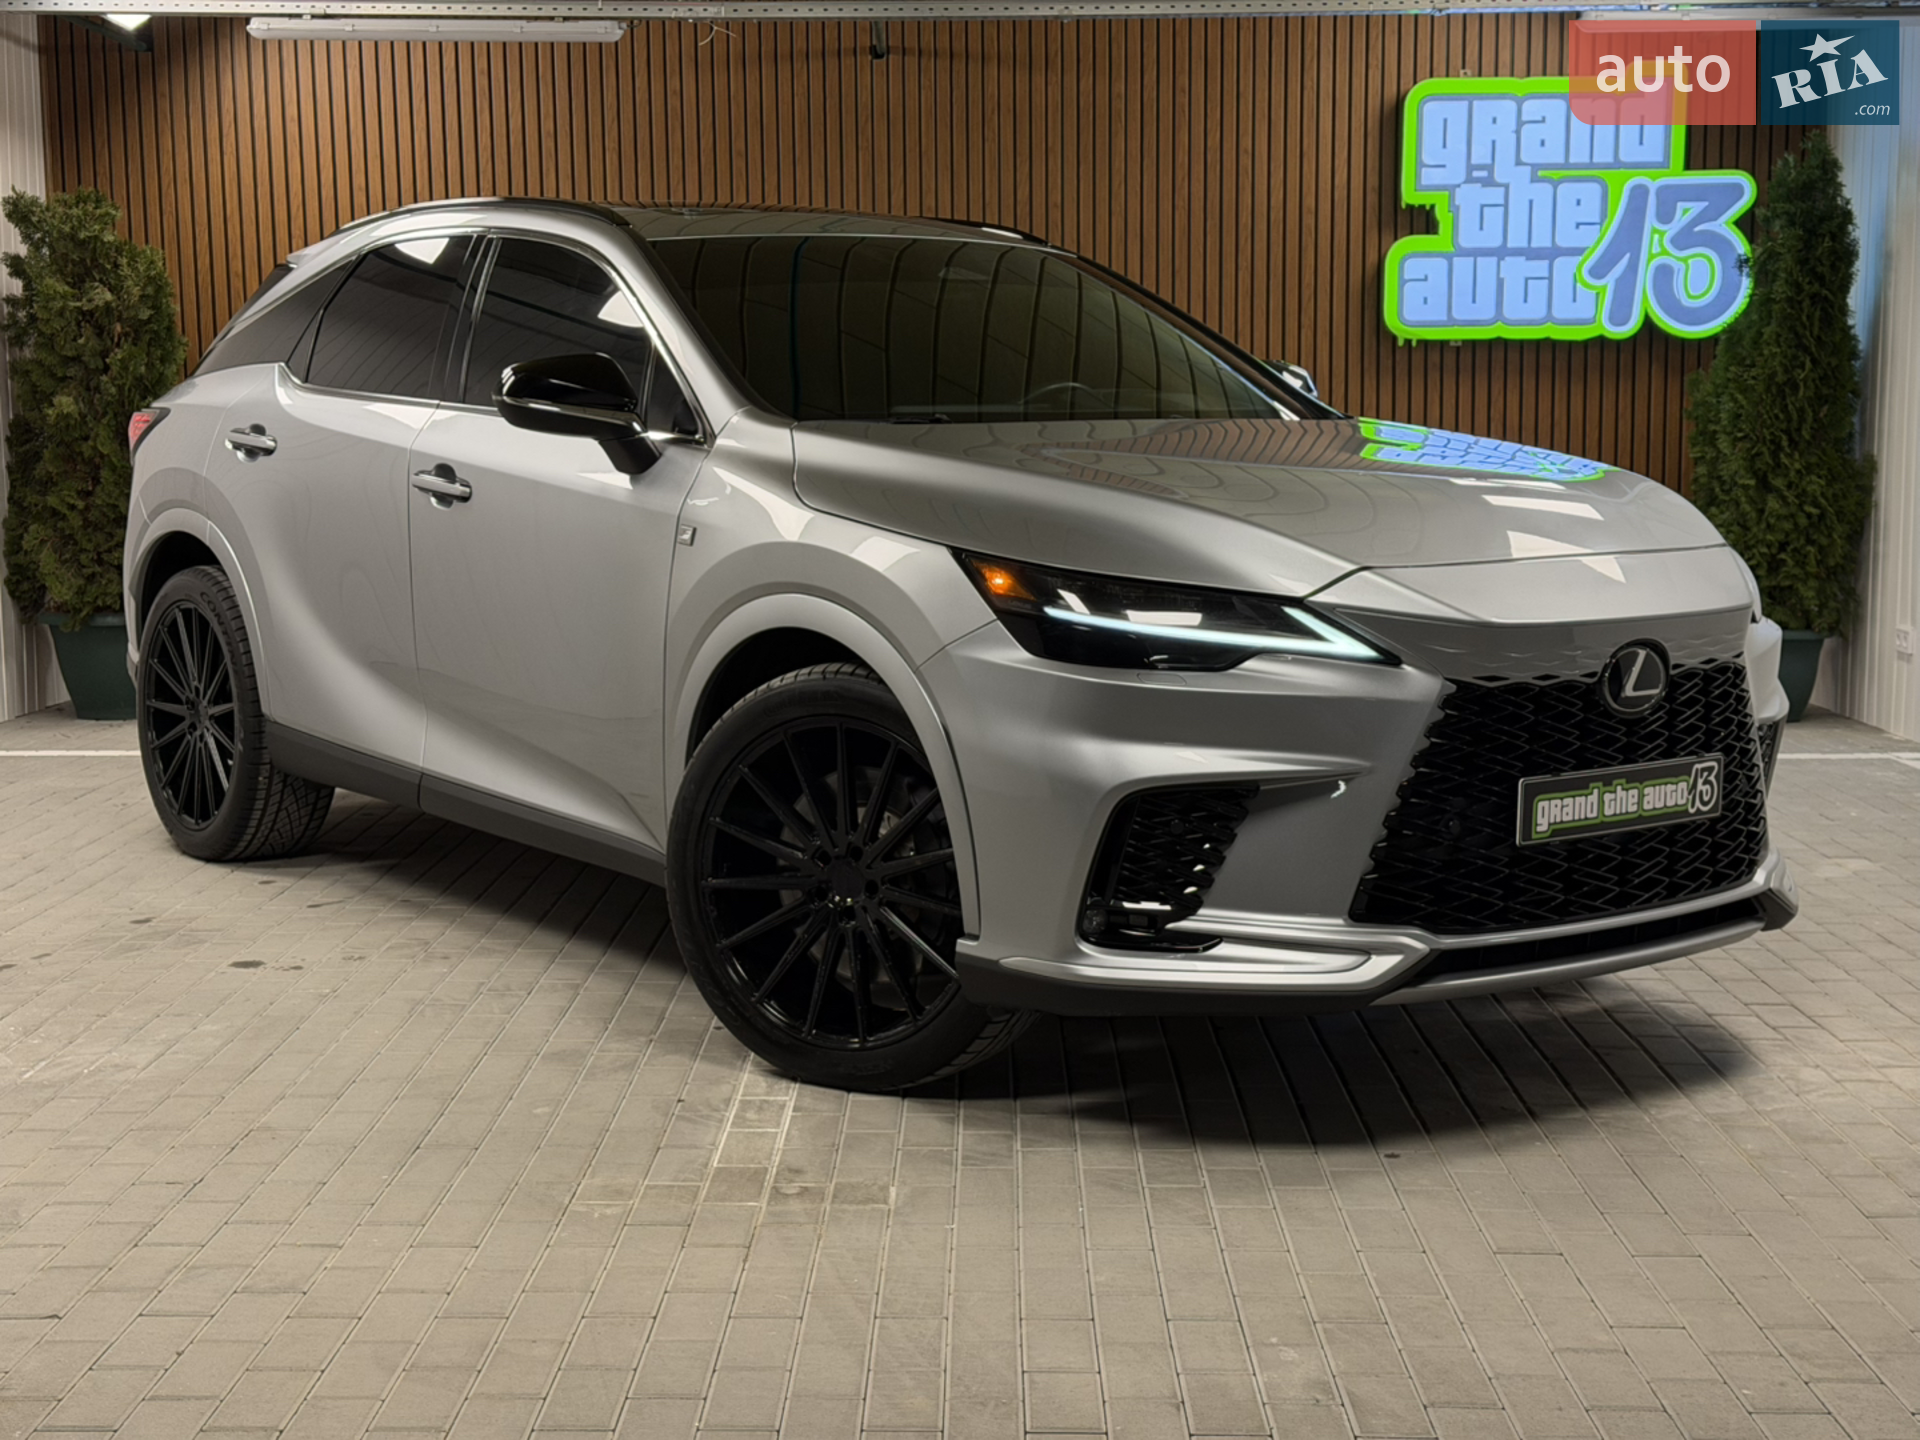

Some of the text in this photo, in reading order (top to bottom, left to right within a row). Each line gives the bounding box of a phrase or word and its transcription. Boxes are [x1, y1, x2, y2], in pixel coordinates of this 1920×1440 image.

[1455, 165, 1602, 249] the
[1402, 176, 1752, 332] auto 13
[1602, 784, 1640, 817] the
[1642, 780, 1689, 812] auto
[1687, 761, 1719, 814] 13
